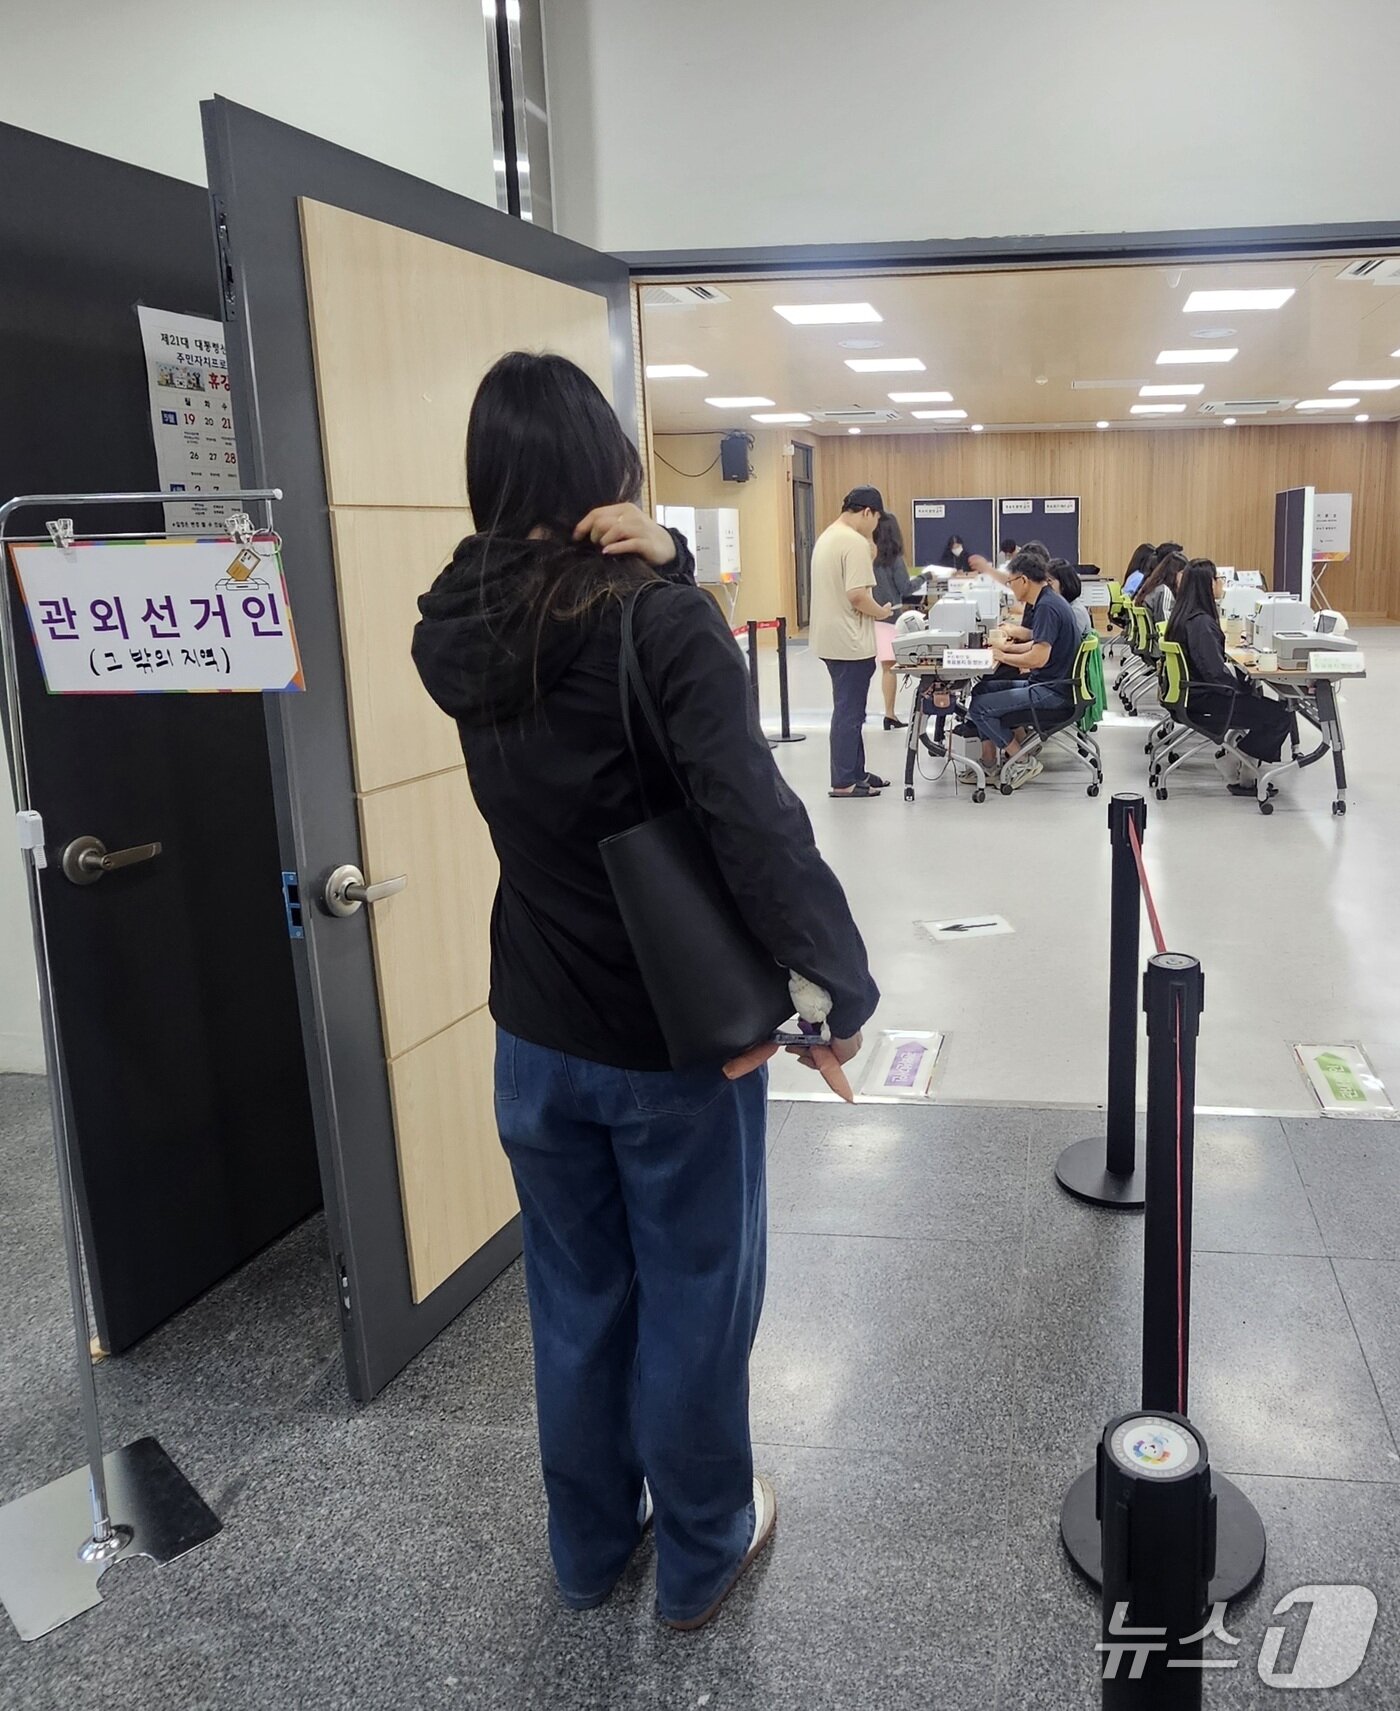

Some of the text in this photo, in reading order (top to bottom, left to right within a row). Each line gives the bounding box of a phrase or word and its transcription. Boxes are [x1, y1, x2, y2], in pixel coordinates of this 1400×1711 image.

[160, 332, 190, 350] 제21대
[183, 413, 196, 426] 19
[204, 417, 214, 427] 20
[221, 417, 232, 430] 21
[189, 451, 237, 465] 26 27 28
[38, 592, 284, 641] 관외선거인
[89, 646, 231, 677] (그 밖의 지역)
